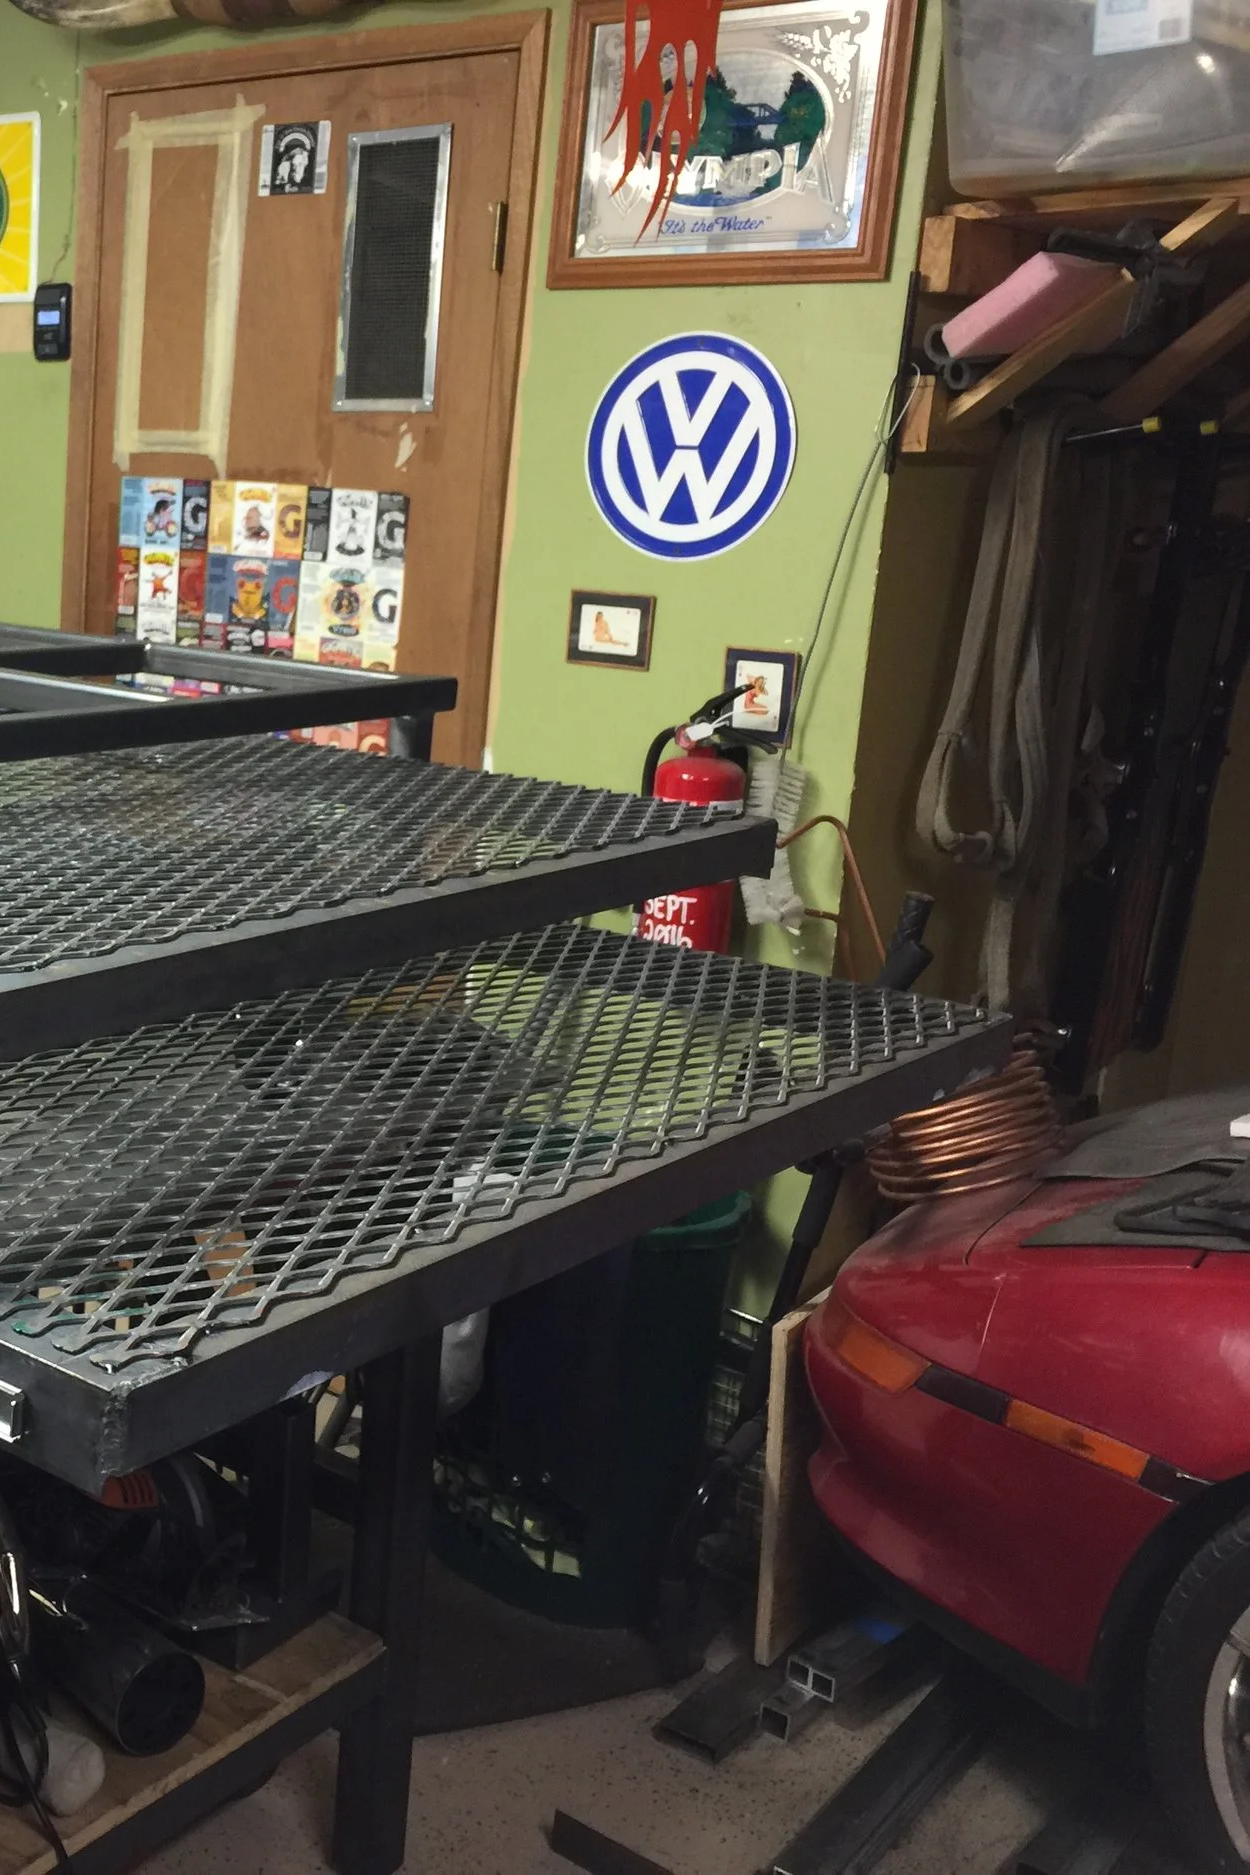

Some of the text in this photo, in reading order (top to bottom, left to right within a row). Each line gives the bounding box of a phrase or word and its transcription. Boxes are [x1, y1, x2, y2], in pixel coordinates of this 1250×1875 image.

[691, 218, 714, 233] the
[272, 577, 297, 614] G
[372, 588, 398, 624] G
